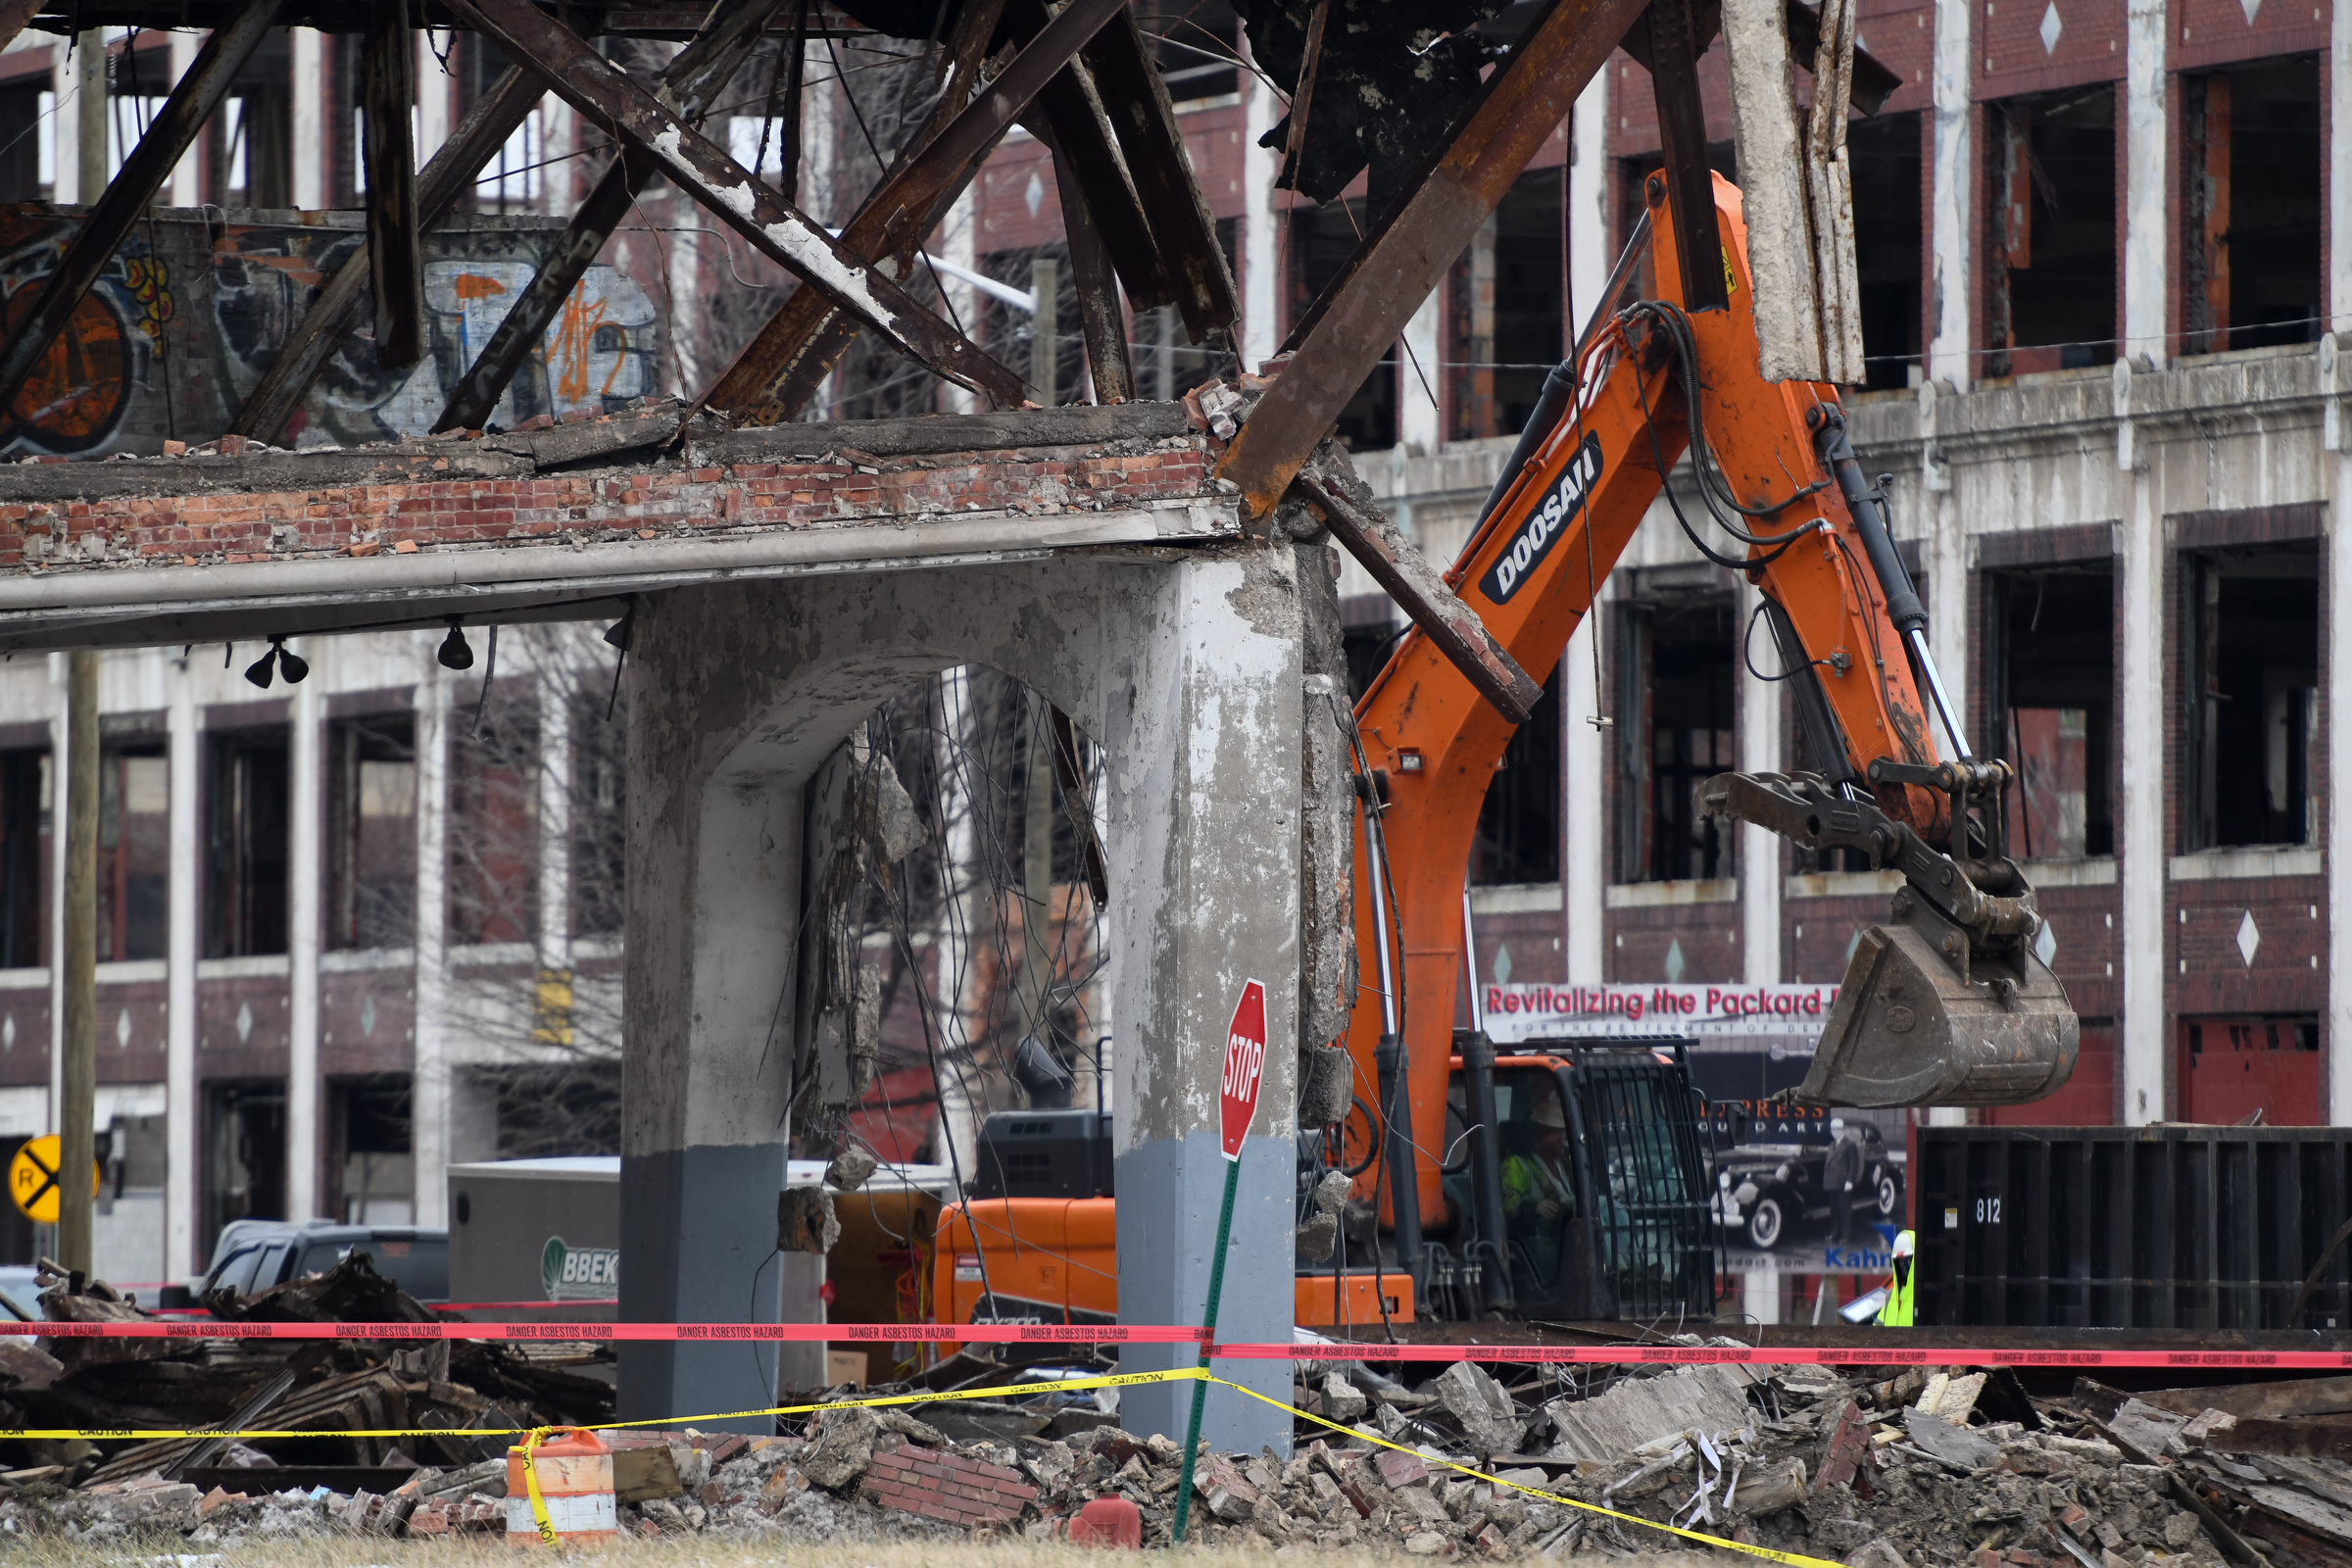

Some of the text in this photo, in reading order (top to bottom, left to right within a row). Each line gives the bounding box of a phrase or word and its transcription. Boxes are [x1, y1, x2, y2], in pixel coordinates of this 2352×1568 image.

[1496, 448, 1595, 596] DOOSAN
[1487, 987, 1645, 1020] Revitalizing
[1653, 987, 1697, 1013] the
[1706, 988, 1821, 1014] Packard
[1224, 1033, 1262, 1103] STOP
[19, 1167, 34, 1188] R
[1976, 1198, 2001, 1224] 812
[561, 1251, 619, 1285] BBEK
[32, 1324, 72, 1336] ASBESTOS
[74, 1324, 104, 1336] HAZARD
[167, 1325, 272, 1337] DANGER ASBESTOS HAZARD
[336, 1325, 442, 1337] DANGER ASBESTOS HAZARD
[507, 1325, 612, 1338] DANGER ASBESTOS HAZARD
[677, 1326, 784, 1339] DANGER ASBESTOS HAZARD
[849, 1326, 956, 1340] DANGER ASBESTOS HAZARD
[1021, 1327, 1128, 1340] DANGER ASBESTOS HAZARD
[1194, 1329, 1214, 1340] DANG
[1200, 1345, 1222, 1355] ZARD
[1289, 1346, 1399, 1357] DANGER ASBESTOS HAZARD
[1464, 1348, 1576, 1359] DANGER ASBESTOS HAZARD
[1641, 1348, 1751, 1361] DANGER ASBESTOS HAZARD
[1817, 1350, 1927, 1362] DANGER ASBESTOS HAZARD
[1992, 1352, 2102, 1364] DANGER ASBESTOS HAZARD
[2167, 1353, 2278, 1366] DANGER ASBESTOS HAZARD
